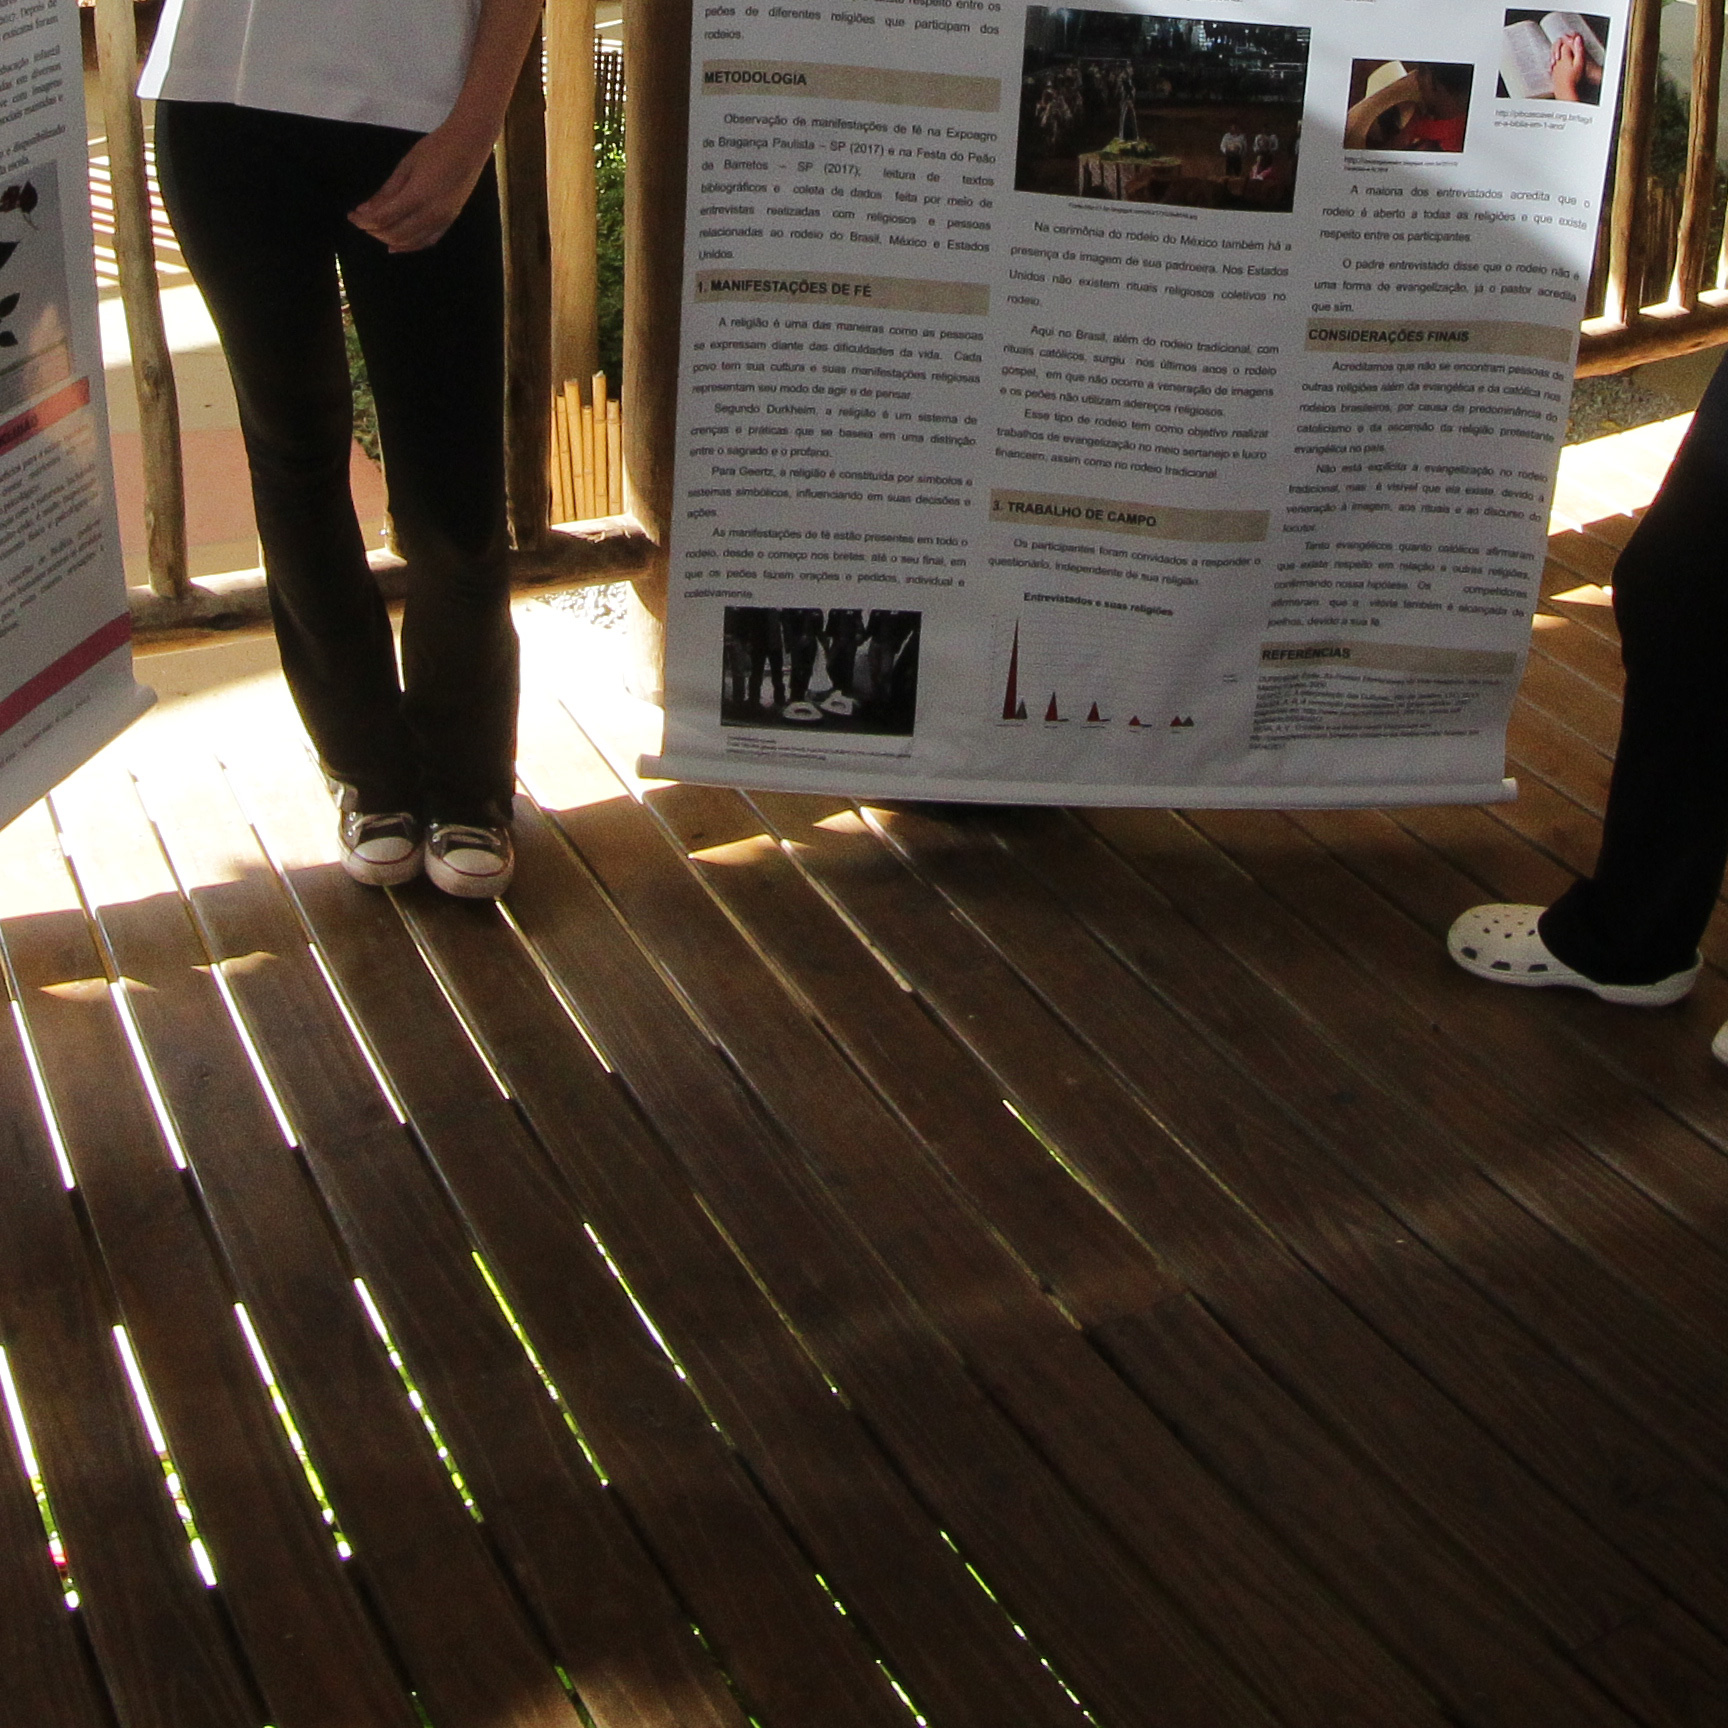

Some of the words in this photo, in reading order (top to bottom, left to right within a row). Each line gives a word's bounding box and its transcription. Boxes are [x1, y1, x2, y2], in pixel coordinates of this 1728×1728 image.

[703, 70, 807, 86] METODOLOGIA
[710, 278, 828, 296] MANIFESTAÇÕES
[831, 281, 850, 296] DE
[853, 283, 872, 298] FÉ
[1308, 328, 1425, 345] CONSIDERAÇÕES
[1426, 330, 1470, 343] FINAIS
[1007, 500, 1082, 519] TRABALHO
[1084, 506, 1104, 522] DE
[1106, 510, 1157, 527] CAMPO
[1261, 645, 1352, 661] REFERÊNCIAS
